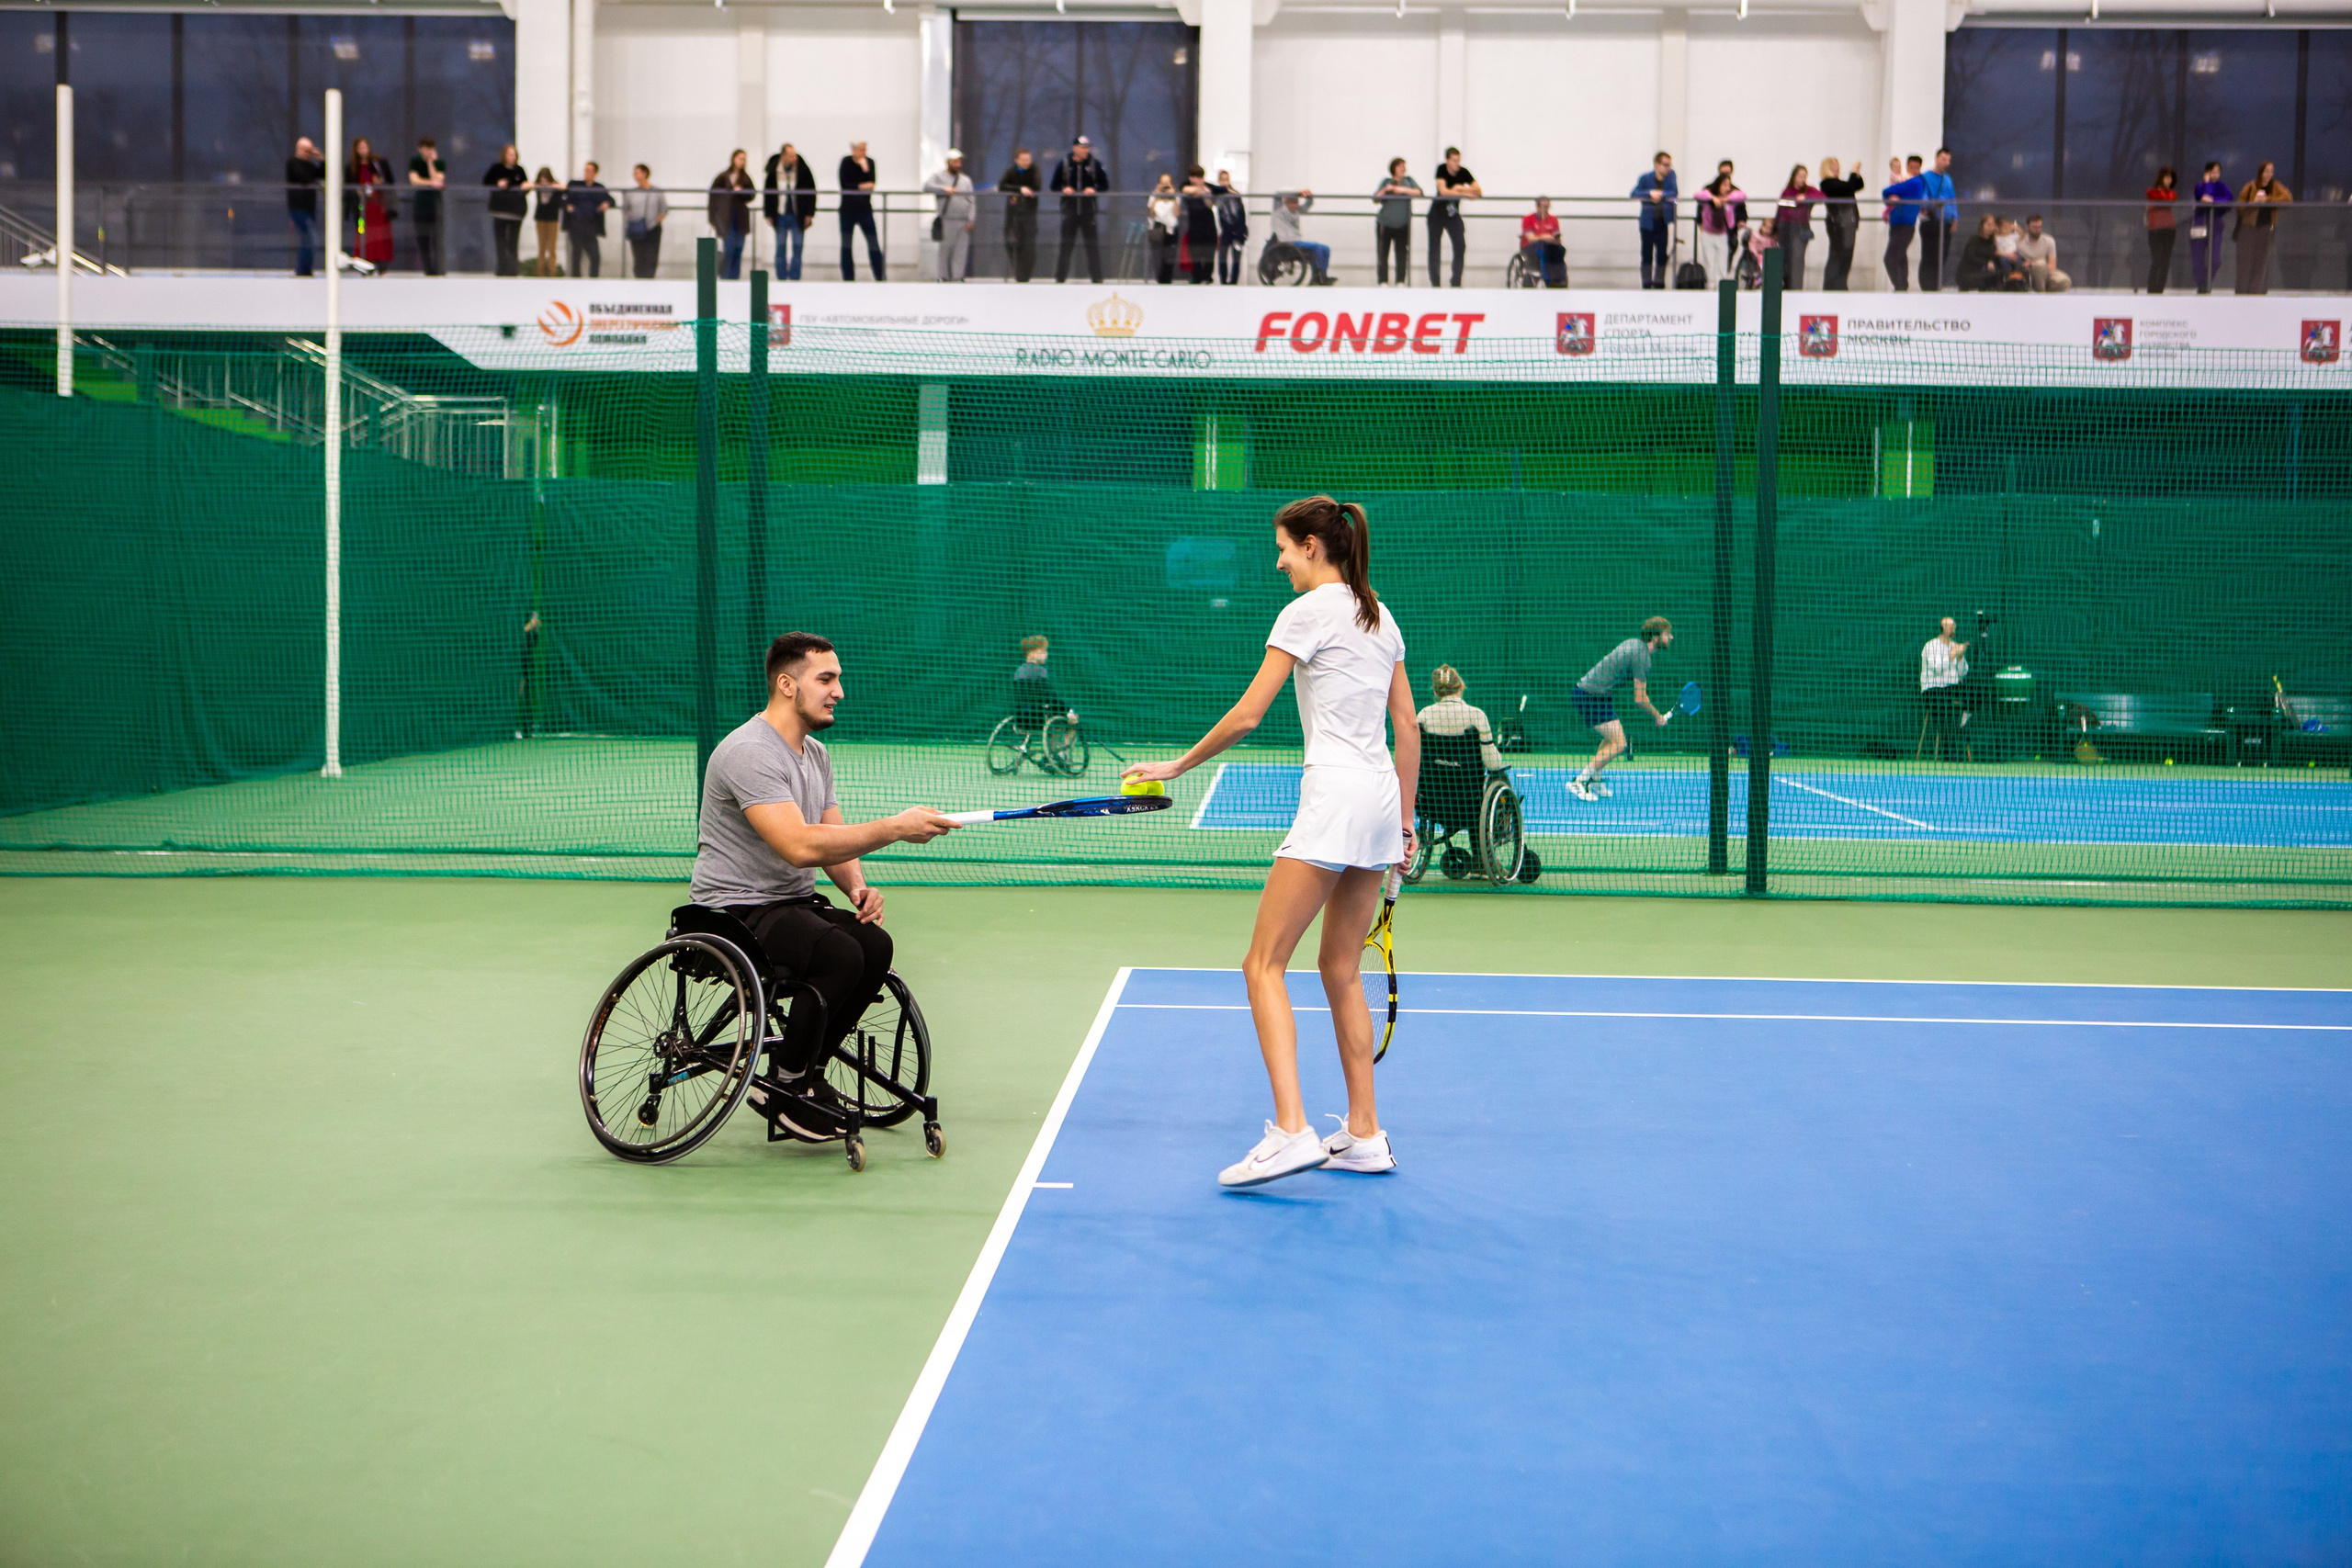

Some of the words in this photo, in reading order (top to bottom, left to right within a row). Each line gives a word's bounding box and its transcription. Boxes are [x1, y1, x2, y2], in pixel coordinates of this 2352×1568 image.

[1603, 313, 1693, 325] ДЕПАРТАМЕНТ
[1848, 318, 1972, 332] ПРАВИТЕЛЬСТВО
[1254, 311, 1485, 354] FONBET
[1603, 328, 1652, 338] СПОРТА
[1848, 334, 1911, 345] МОСКВЫ
[1016, 348, 1075, 367] RADIO
[1082, 349, 1148, 367] MONTE
[1154, 350, 1211, 368] CARLO
